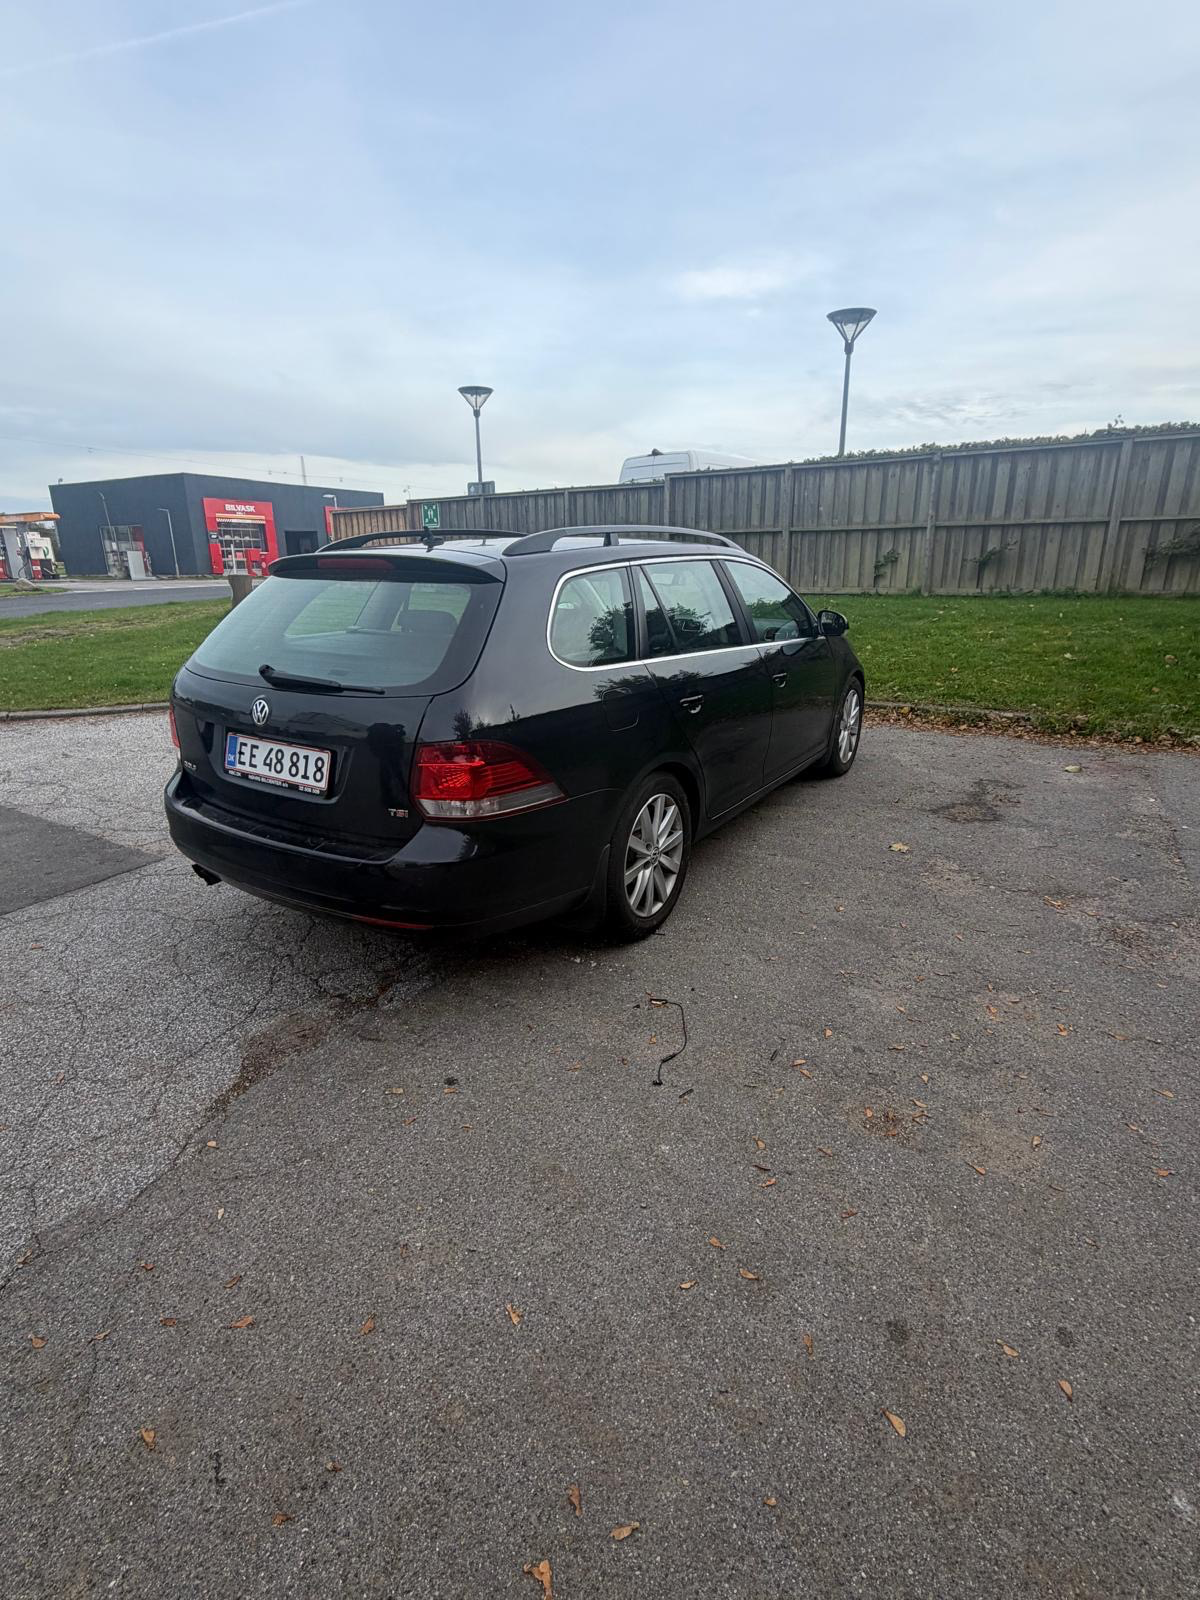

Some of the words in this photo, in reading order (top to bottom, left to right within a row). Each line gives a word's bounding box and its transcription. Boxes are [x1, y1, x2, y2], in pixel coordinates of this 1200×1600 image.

[225, 503, 256, 513] BILVASK
[227, 753, 235, 762] DK
[238, 741, 259, 769] EE
[263, 747, 284, 774] 48
[288, 751, 325, 783] 818
